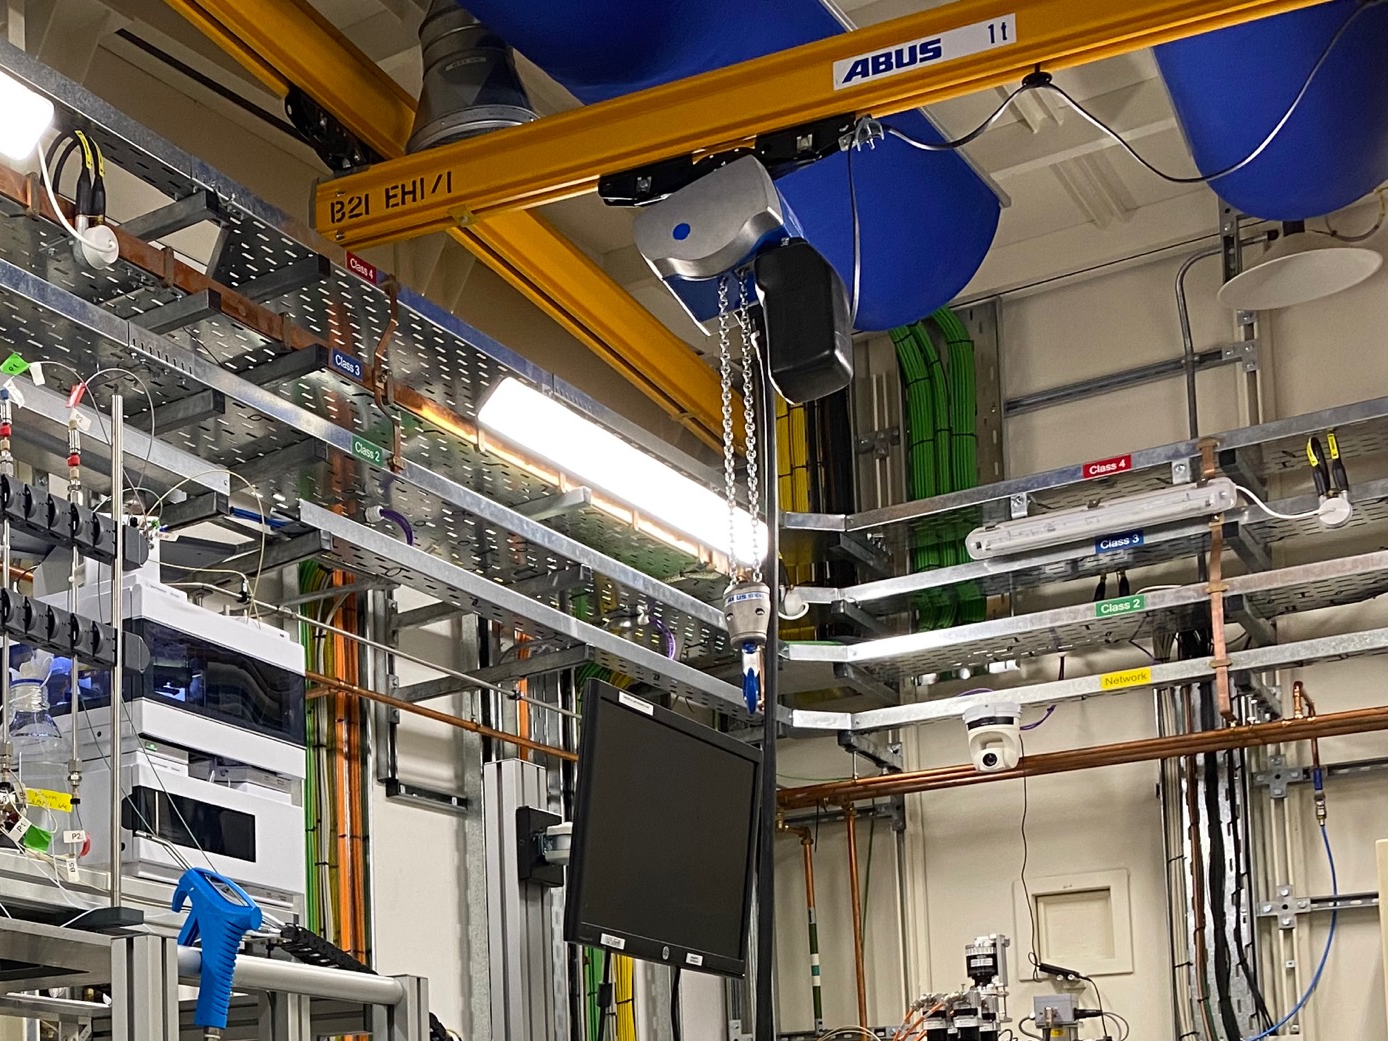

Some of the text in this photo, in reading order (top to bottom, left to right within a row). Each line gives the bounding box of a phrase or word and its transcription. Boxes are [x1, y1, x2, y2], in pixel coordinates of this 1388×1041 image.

[842, 21, 1008, 84] ABUS 1 t
[330, 193, 370, 224] B21
[349, 257, 374, 280] Class 4
[335, 353, 361, 376] Class 3
[354, 441, 380, 462] Class 2
[1089, 458, 1126, 476] Class 4
[1100, 534, 1140, 550] Class 3
[1100, 598, 1140, 614] Class 2
[1105, 672, 1148, 687] Network
[17, 823, 26, 832] P1
